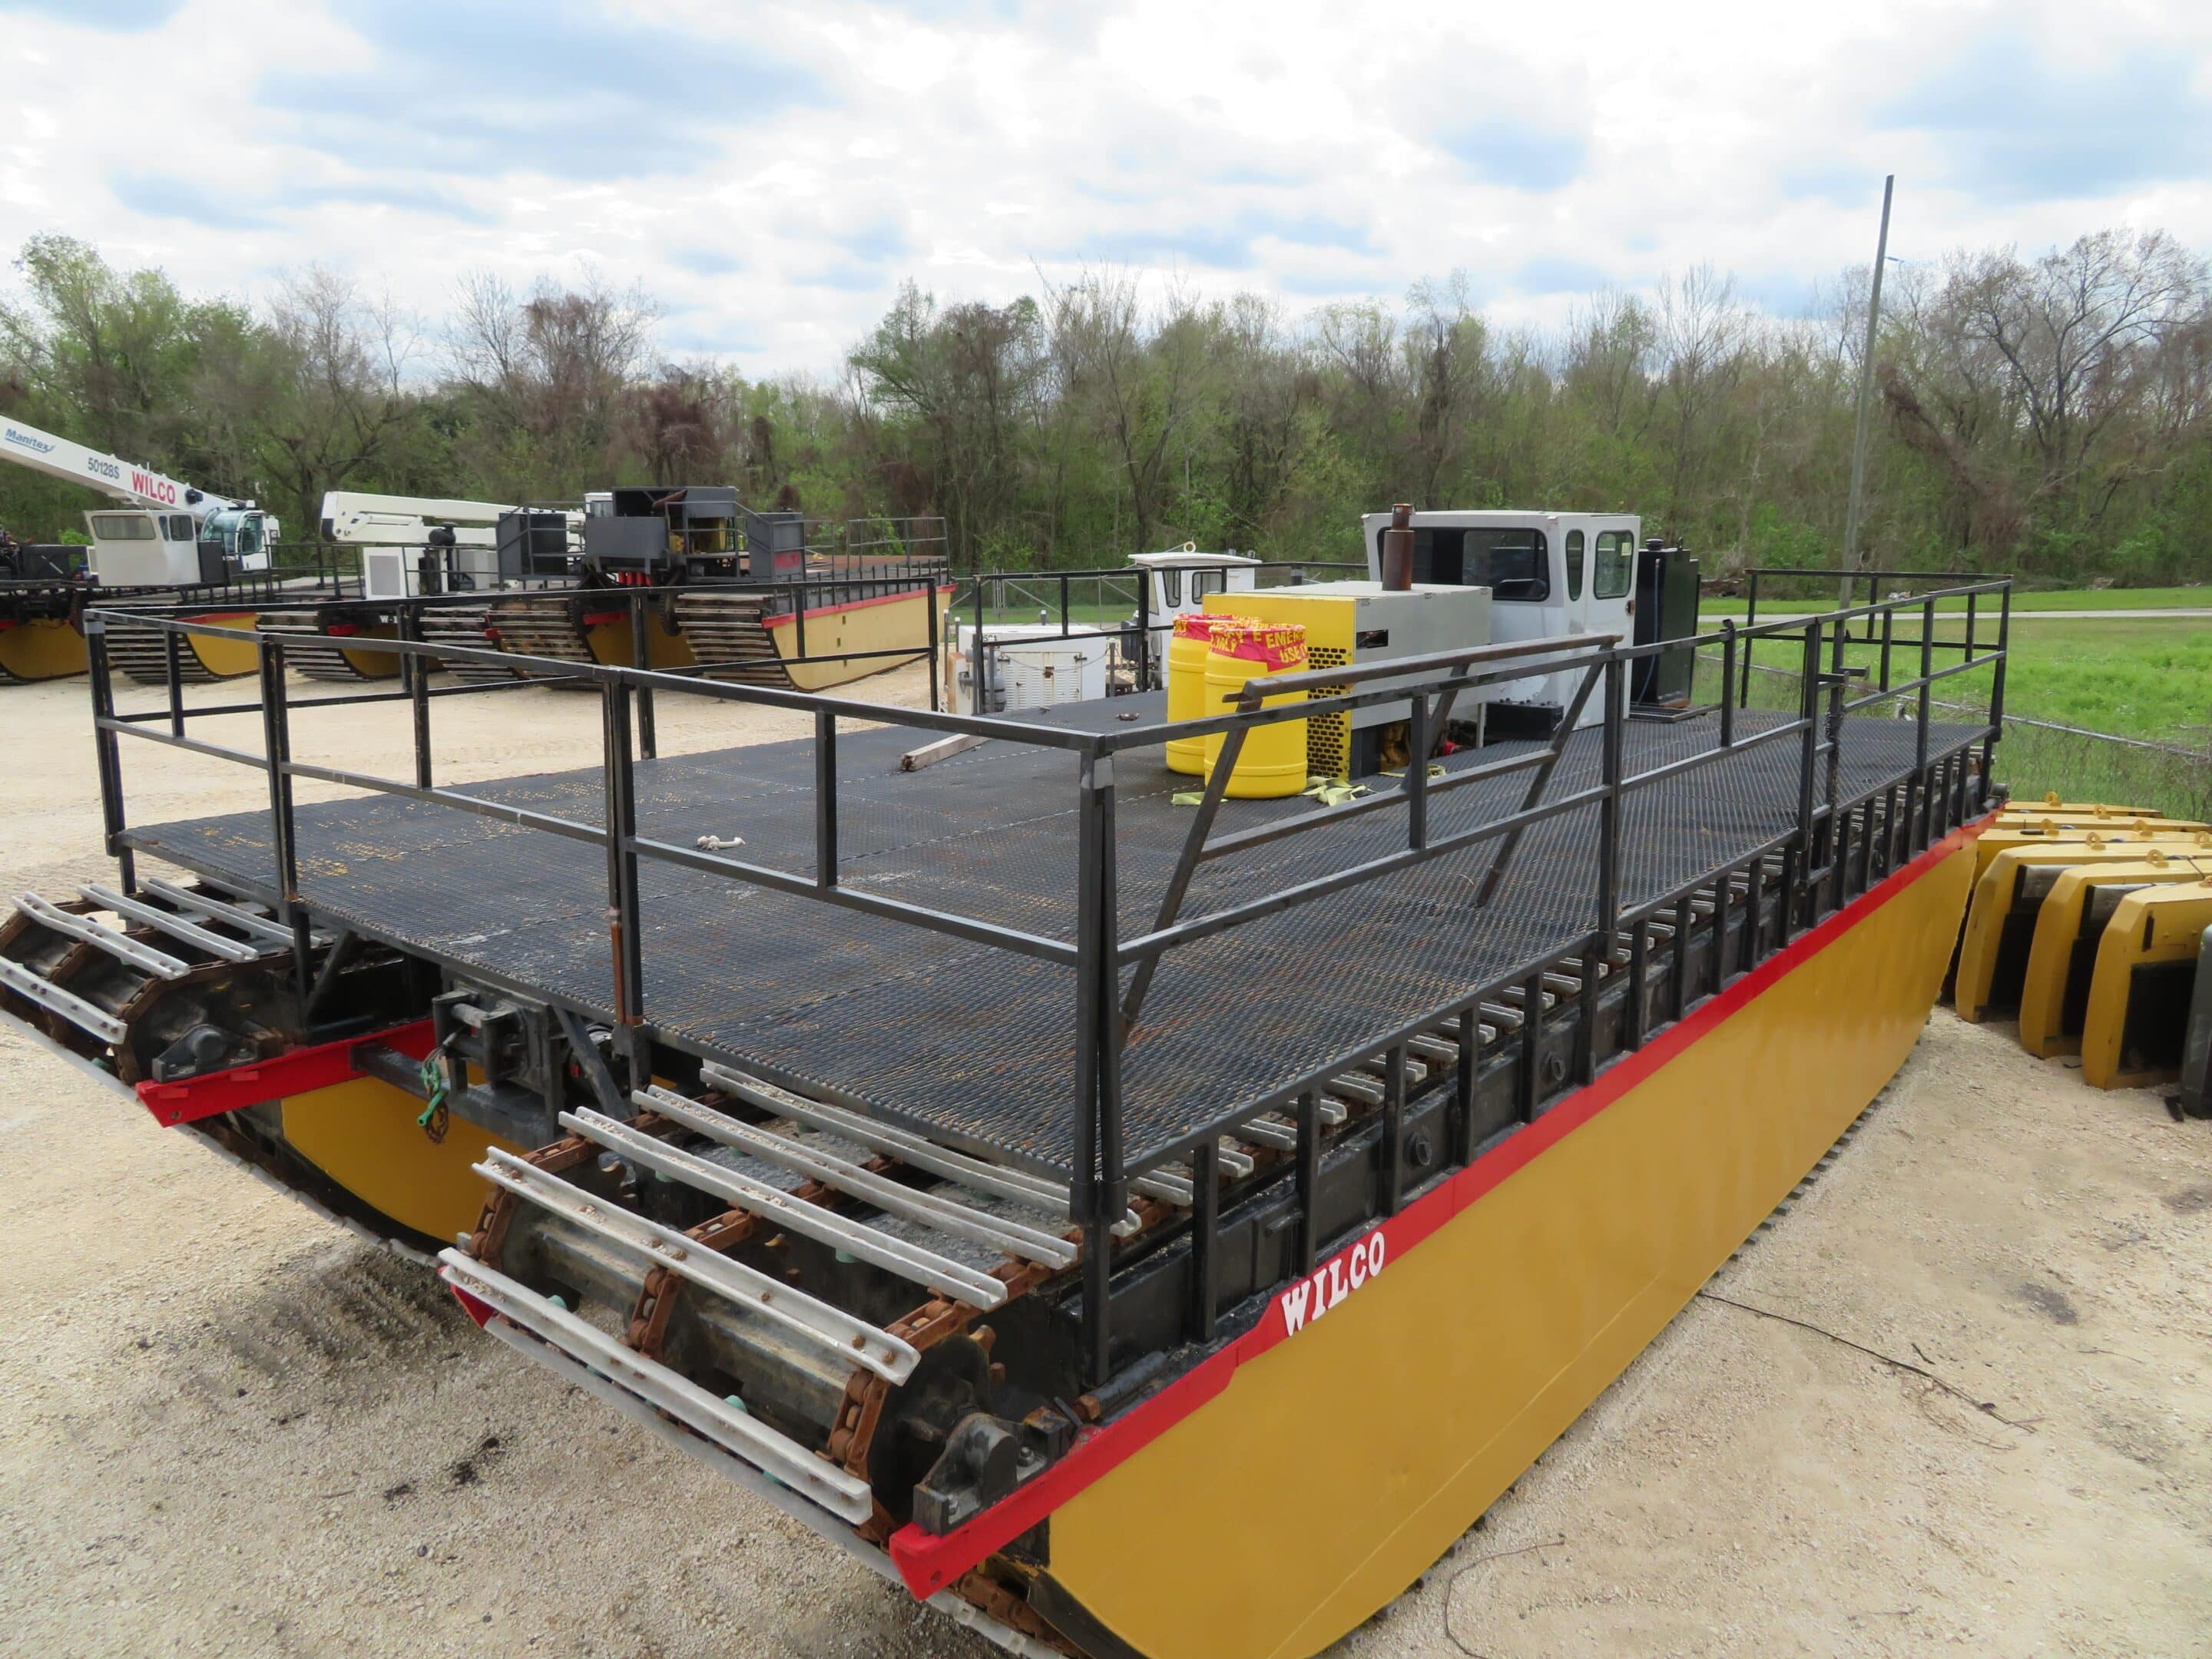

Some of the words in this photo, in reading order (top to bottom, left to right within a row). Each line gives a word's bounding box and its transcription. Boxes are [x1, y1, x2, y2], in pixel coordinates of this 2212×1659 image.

[5, 428, 52, 452] Manitex
[88, 457, 120, 479] 50128S
[131, 470, 175, 505] WILCO
[1281, 1232, 1385, 1336] WILCO
